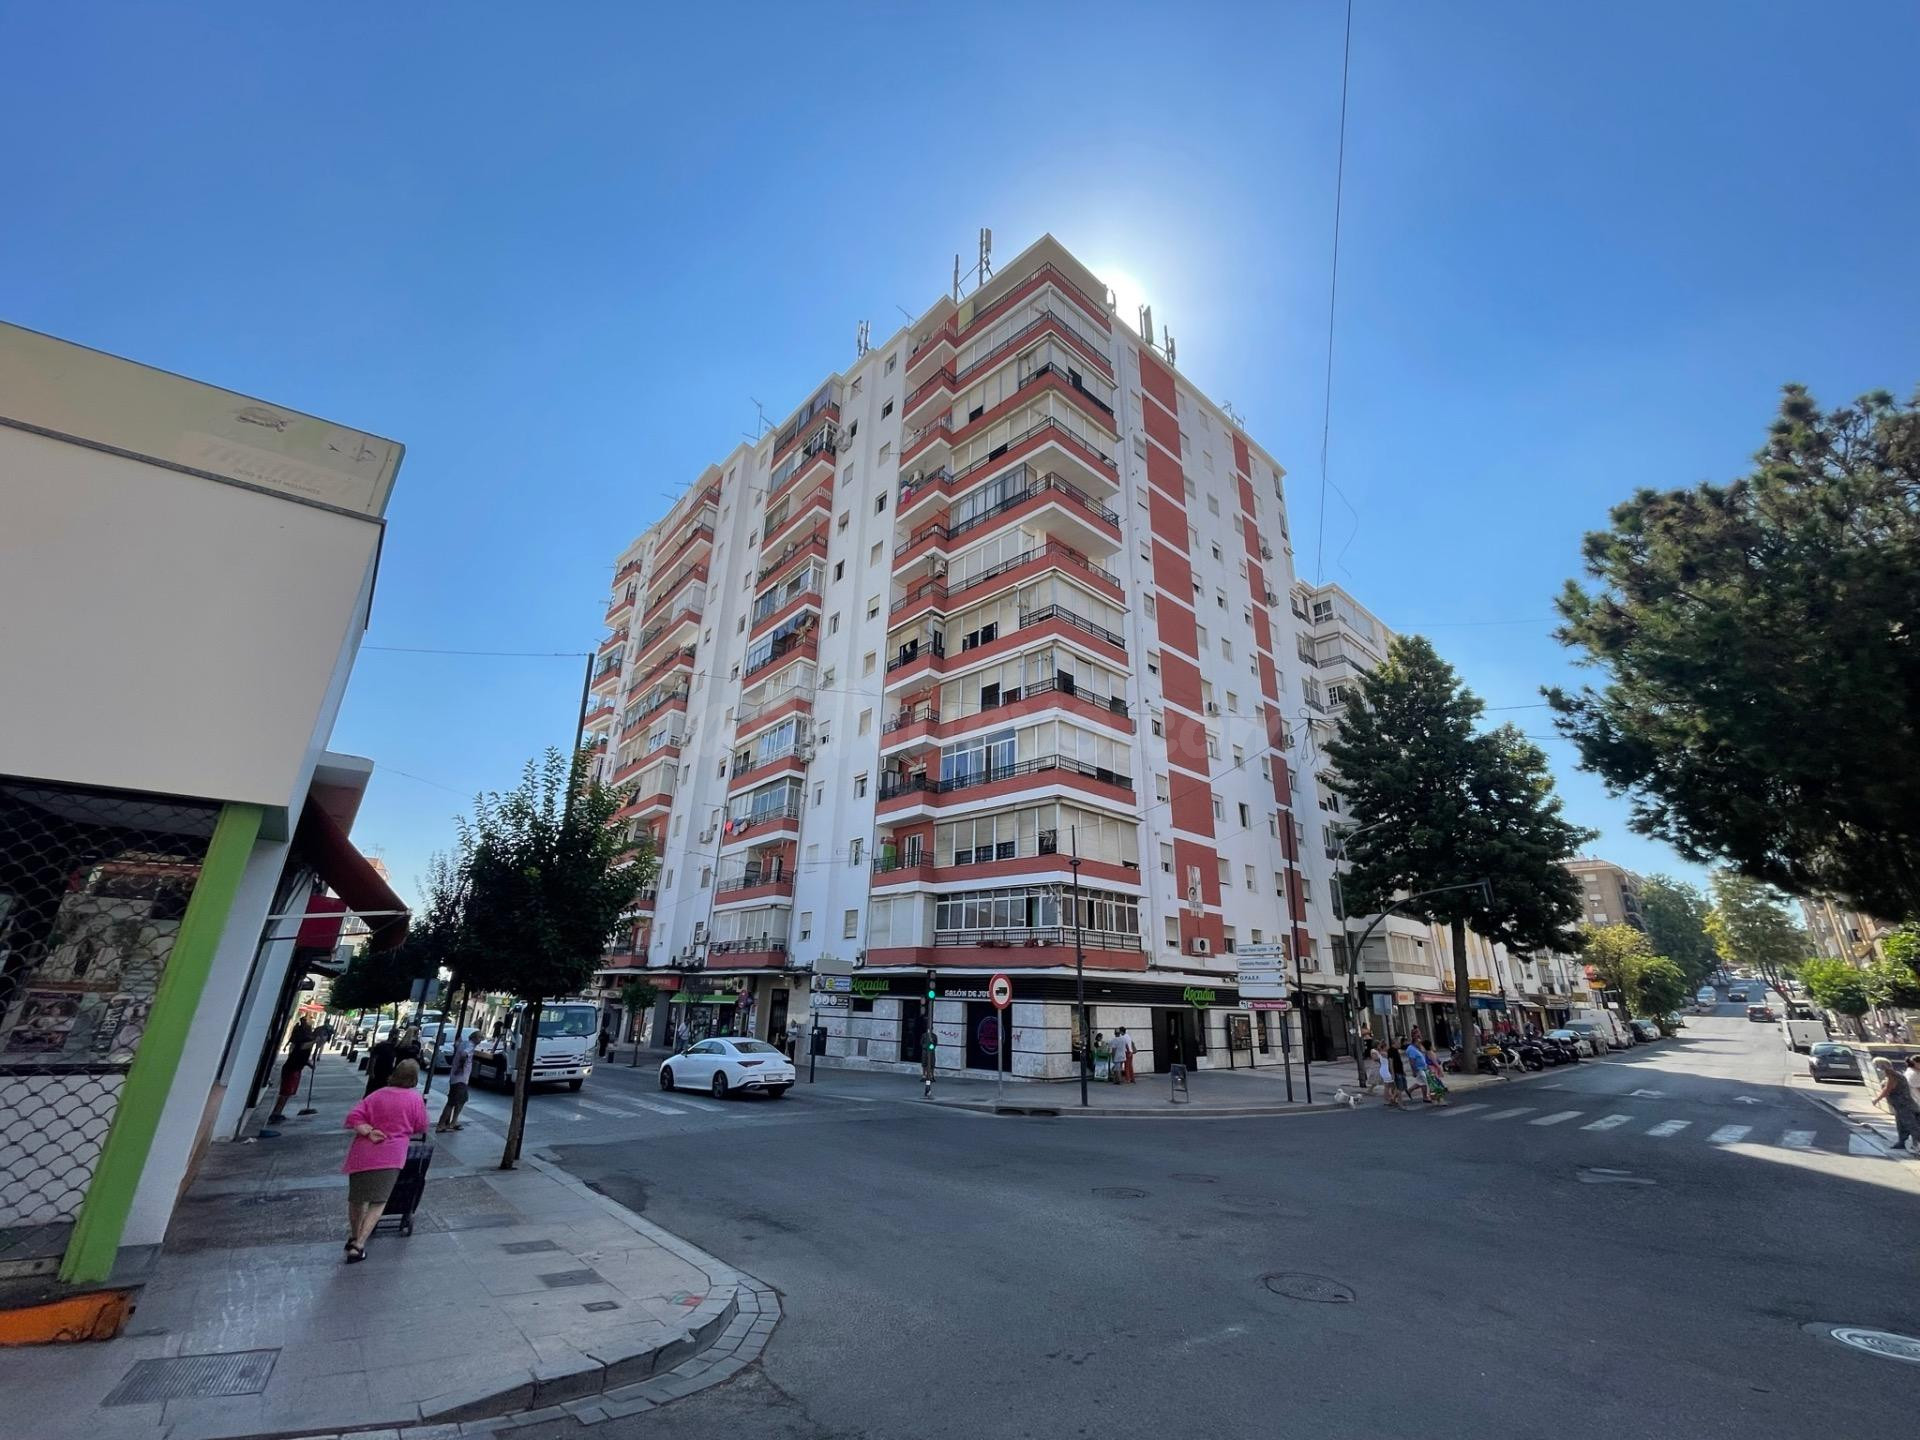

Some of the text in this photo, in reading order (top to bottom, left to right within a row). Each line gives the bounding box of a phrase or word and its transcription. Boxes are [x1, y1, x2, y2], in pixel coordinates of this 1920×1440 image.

[851, 977, 890, 999] Arcadia
[944, 988, 967, 998] SALÓN
[967, 990, 977, 998] DE
[1183, 986, 1216, 1009] Arcadia
